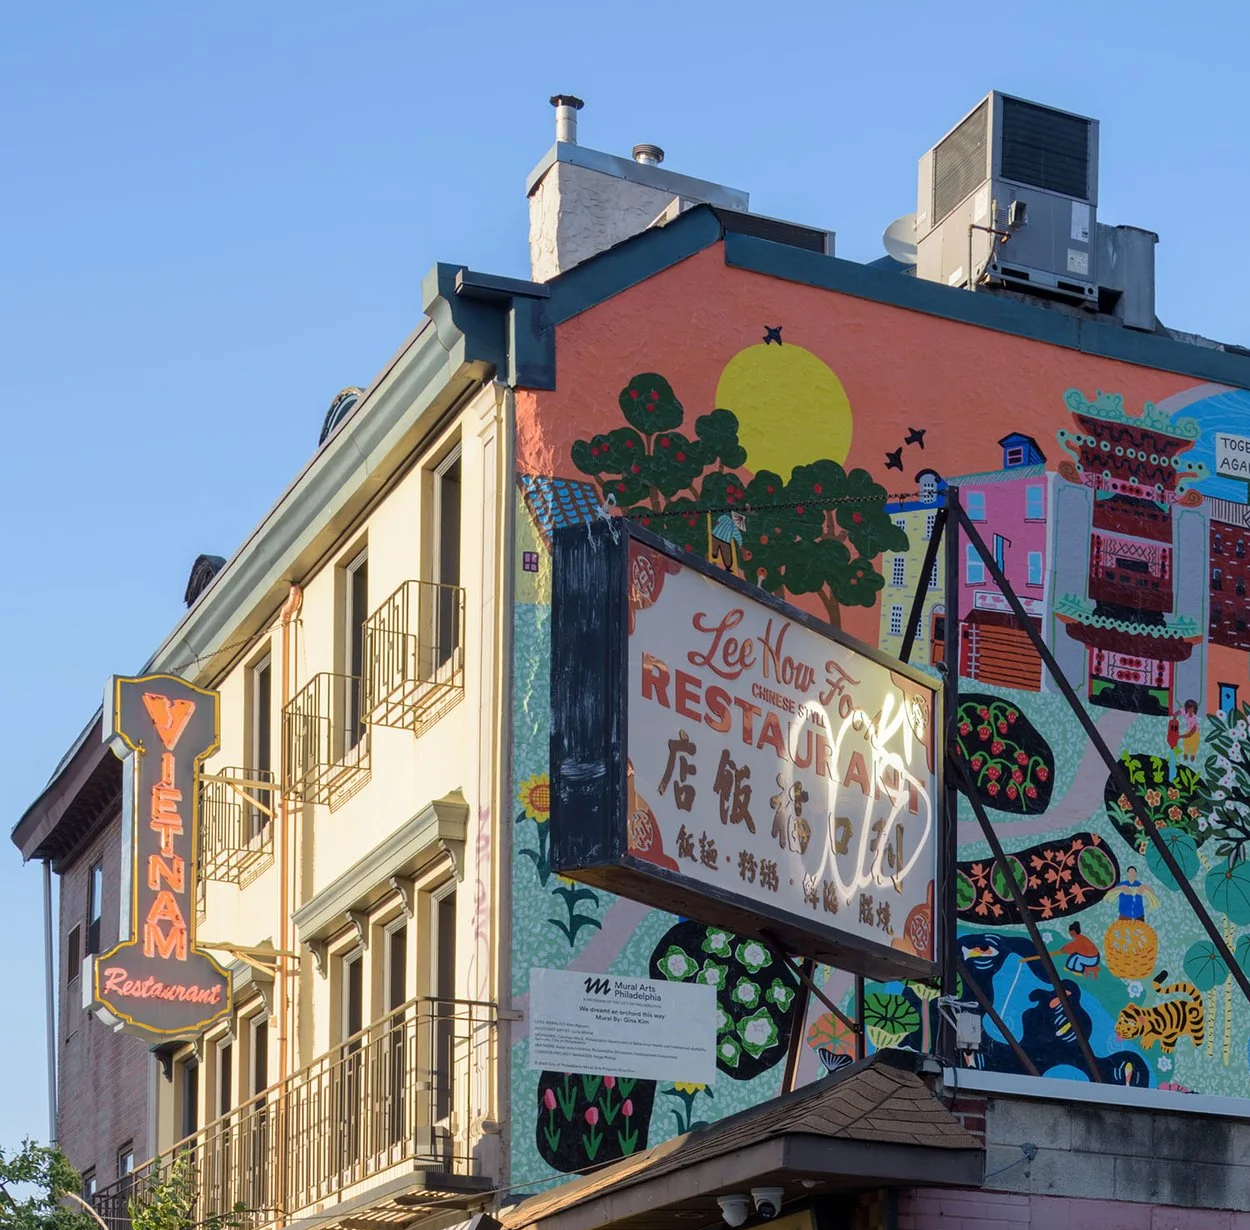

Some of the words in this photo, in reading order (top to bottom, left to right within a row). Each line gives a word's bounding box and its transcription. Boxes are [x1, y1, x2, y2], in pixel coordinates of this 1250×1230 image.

[687, 609, 758, 681] Lee
[756, 618, 816, 693] How
[751, 682, 797, 716] CHINESE
[142, 691, 197, 962] VIETNAM
[103, 967, 222, 1006] Restaurant
[614, 981, 638, 990] Mural
[639, 984, 656, 993] Arts
[614, 990, 662, 1001] Philadelphia
